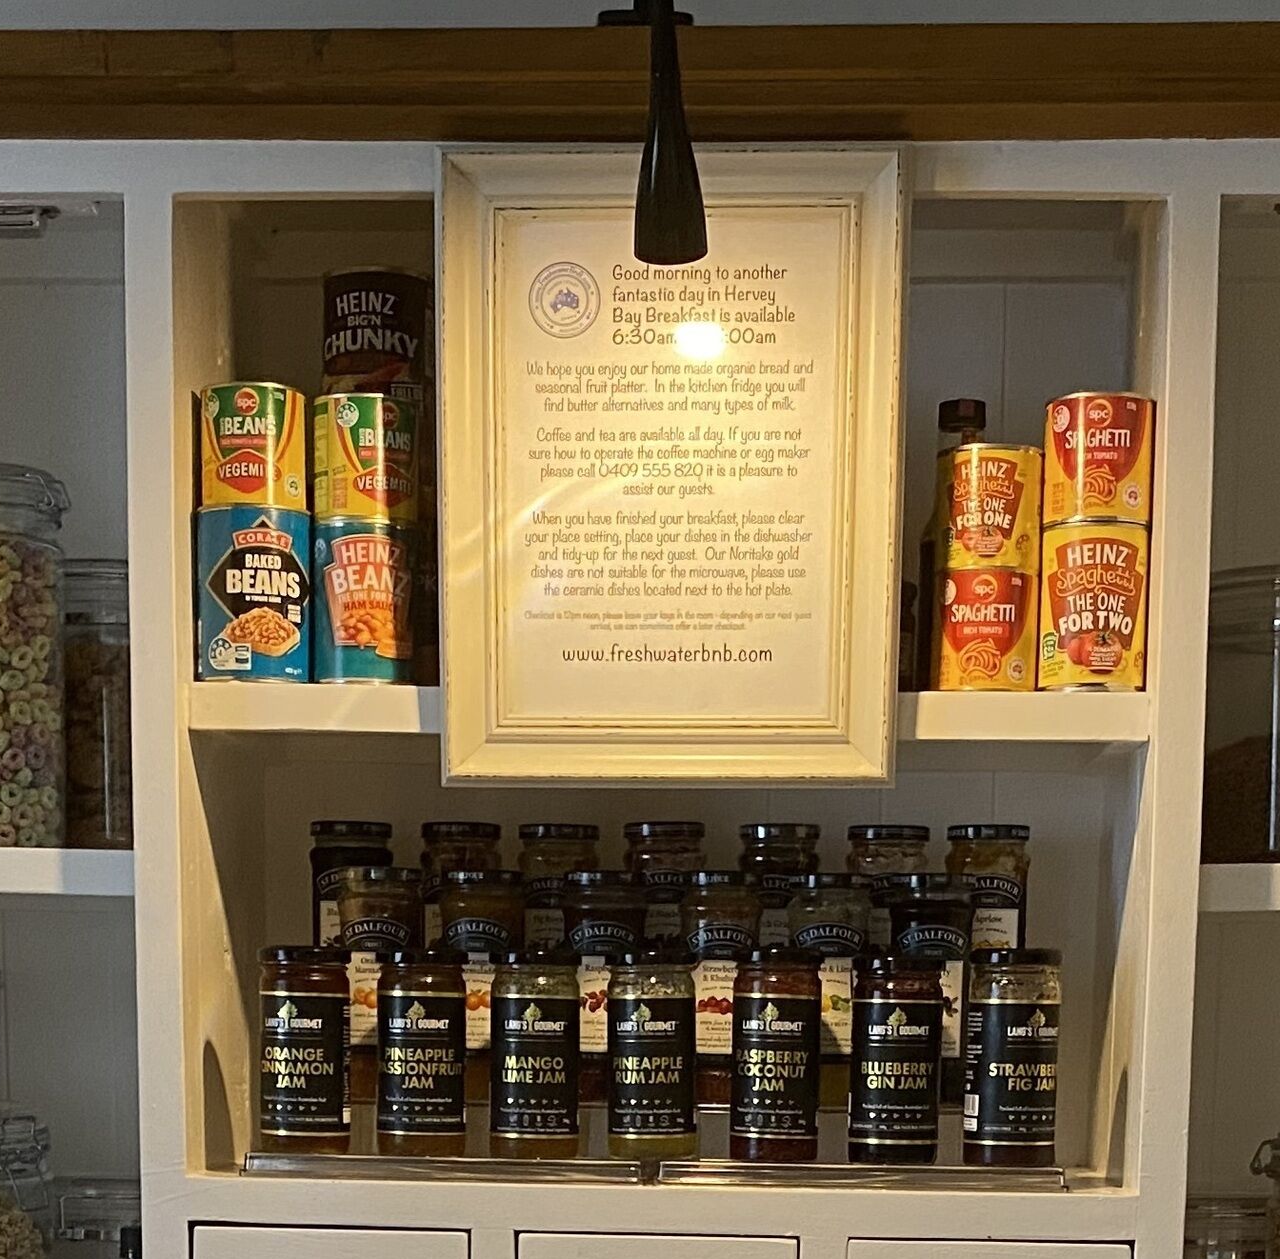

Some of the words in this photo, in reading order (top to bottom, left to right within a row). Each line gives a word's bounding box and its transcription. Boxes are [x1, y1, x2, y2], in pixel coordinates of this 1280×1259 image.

[613, 265, 649, 280] Good
[653, 266, 711, 283] morning
[716, 267, 729, 280] to
[733, 268, 788, 280] another
[336, 292, 394, 316] HEINZ
[612, 286, 674, 302] fantastic
[679, 289, 704, 305] day
[708, 287, 720, 301] in
[725, 288, 775, 305] Hervey
[613, 308, 640, 327] Bay
[647, 307, 715, 322] Breakfast
[720, 309, 730, 322] is
[735, 307, 795, 322] available
[325, 329, 418, 361] CHUNKY
[527, 362, 543, 375] We
[546, 361, 571, 378] hope
[576, 365, 595, 378] you
[598, 362, 627, 379] enjoy
[631, 364, 648, 375] our
[652, 362, 680, 375] home
[684, 361, 712, 374] made
[716, 362, 755, 378] organic
[759, 360, 789, 374] bread
[794, 360, 813, 374] and
[544, 398, 564, 412] find
[567, 399, 598, 411] butter
[602, 398, 663, 412] alternatives
[668, 397, 687, 411] and
[692, 400, 720, 415] many
[725, 398, 753, 416] types
[757, 398, 768, 411] of
[1088, 409, 1108, 422] spc
[226, 417, 276, 435] BEANS
[1065, 429, 1130, 449] SPAGHETTI
[961, 461, 1006, 479] HEINZ
[962, 500, 981, 513] THE
[984, 497, 1006, 513] ONE
[956, 512, 982, 530] FOR
[984, 513, 1012, 529] ONE
[245, 554, 282, 569] BAKED
[342, 542, 400, 564] HEINZ
[1067, 544, 1128, 567] HEINZ
[226, 569, 301, 598] BEANS
[332, 565, 409, 595] BEANZ
[1056, 567, 1135, 596] Spaghetti
[1067, 594, 1094, 611] THE
[1098, 593, 1126, 613] ONE
[951, 604, 1015, 623] SPAGHETTI
[1059, 615, 1094, 635] FOR
[1097, 612, 1133, 635] TWO
[563, 643, 772, 662] www.freshwaterbnb.com
[265, 1047, 324, 1061] ORANGE
[385, 1048, 454, 1061] PINEAPPLE
[505, 1056, 563, 1069] MANGO
[613, 1057, 683, 1069] PINEAPPLE
[736, 1050, 808, 1065] RASPBERRY
[503, 1070, 533, 1083] LIME
[536, 1071, 566, 1083] JAM
[615, 1071, 645, 1084] RUM
[648, 1072, 679, 1084] JAM
[738, 1065, 806, 1078] COCONUT
[861, 1062, 933, 1075] BLUEBERRY
[276, 1075, 306, 1088] JAM
[402, 1076, 434, 1089] JAM
[753, 1078, 785, 1092] JAM
[867, 1077, 897, 1090] GIN
[900, 1077, 927, 1089] JAM
[1008, 1078, 1032, 1091] FIG
